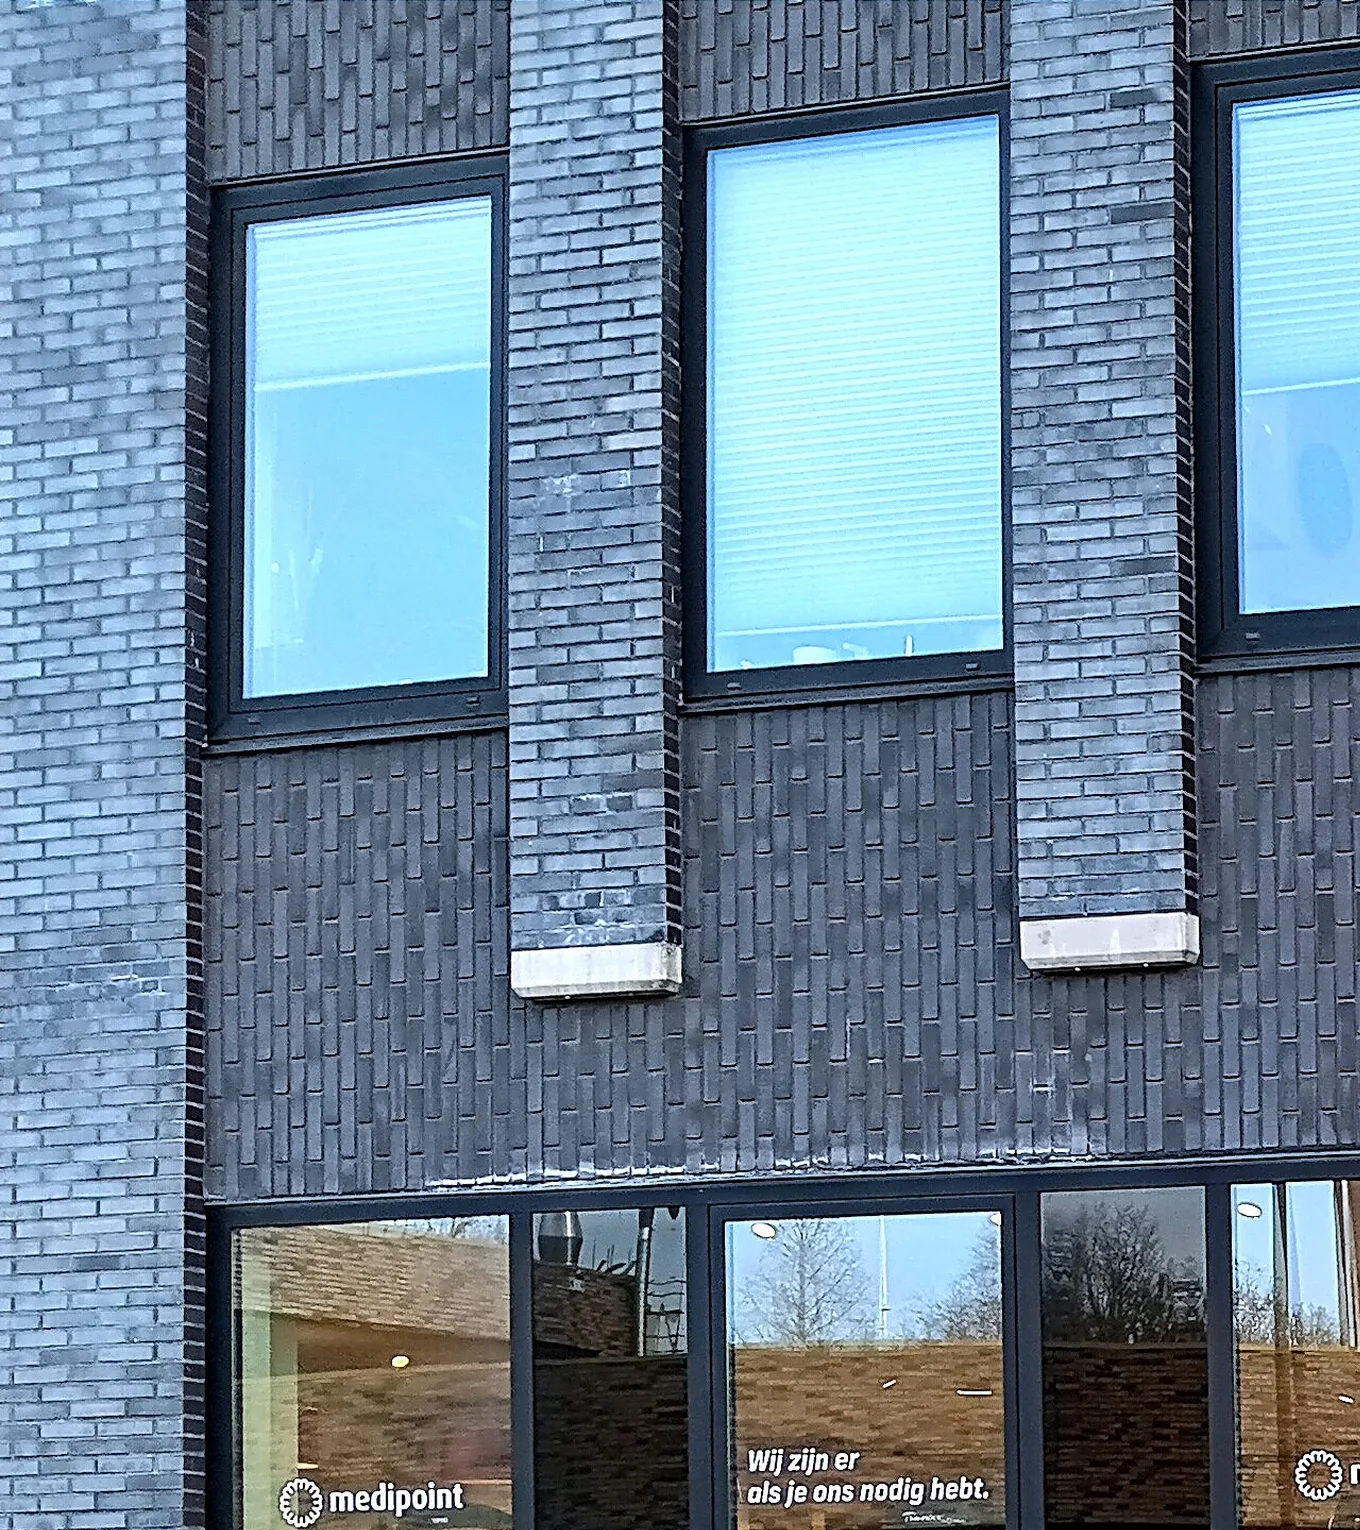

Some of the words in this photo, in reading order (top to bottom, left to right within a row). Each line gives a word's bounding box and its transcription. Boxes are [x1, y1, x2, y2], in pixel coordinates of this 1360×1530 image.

[747, 1447, 784, 1477] Wij
[788, 1447, 829, 1476] zijn
[833, 1450, 860, 1471] er
[328, 1481, 464, 1517] medipoint
[747, 1480, 782, 1505] als
[783, 1480, 808, 1509] je
[812, 1483, 854, 1504] ons
[859, 1476, 925, 1507] nodig
[929, 1475, 990, 1501] hebt.
